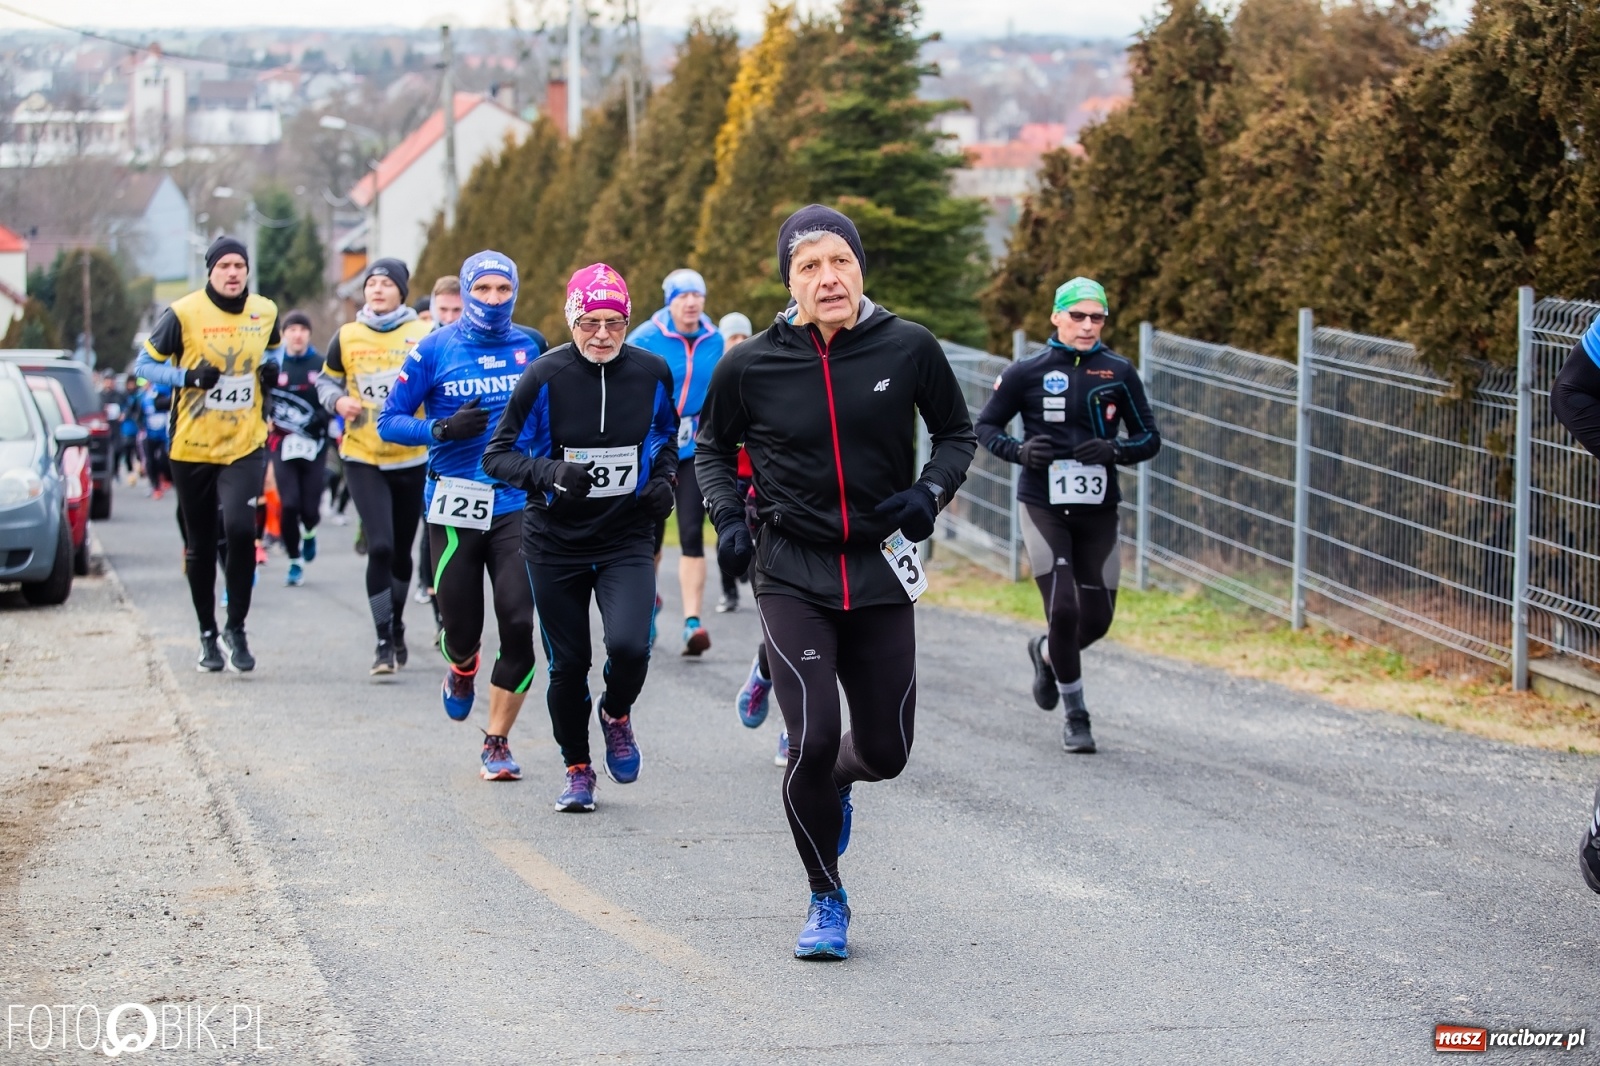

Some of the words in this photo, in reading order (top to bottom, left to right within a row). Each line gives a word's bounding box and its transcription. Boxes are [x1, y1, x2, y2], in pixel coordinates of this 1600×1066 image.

[208, 388, 251, 403] 443
[443, 373, 523, 396] RUNNE
[874, 378, 891, 392] 4F
[1056, 475, 1103, 496] 133
[436, 495, 489, 520] 125
[898, 545, 919, 585] 3
